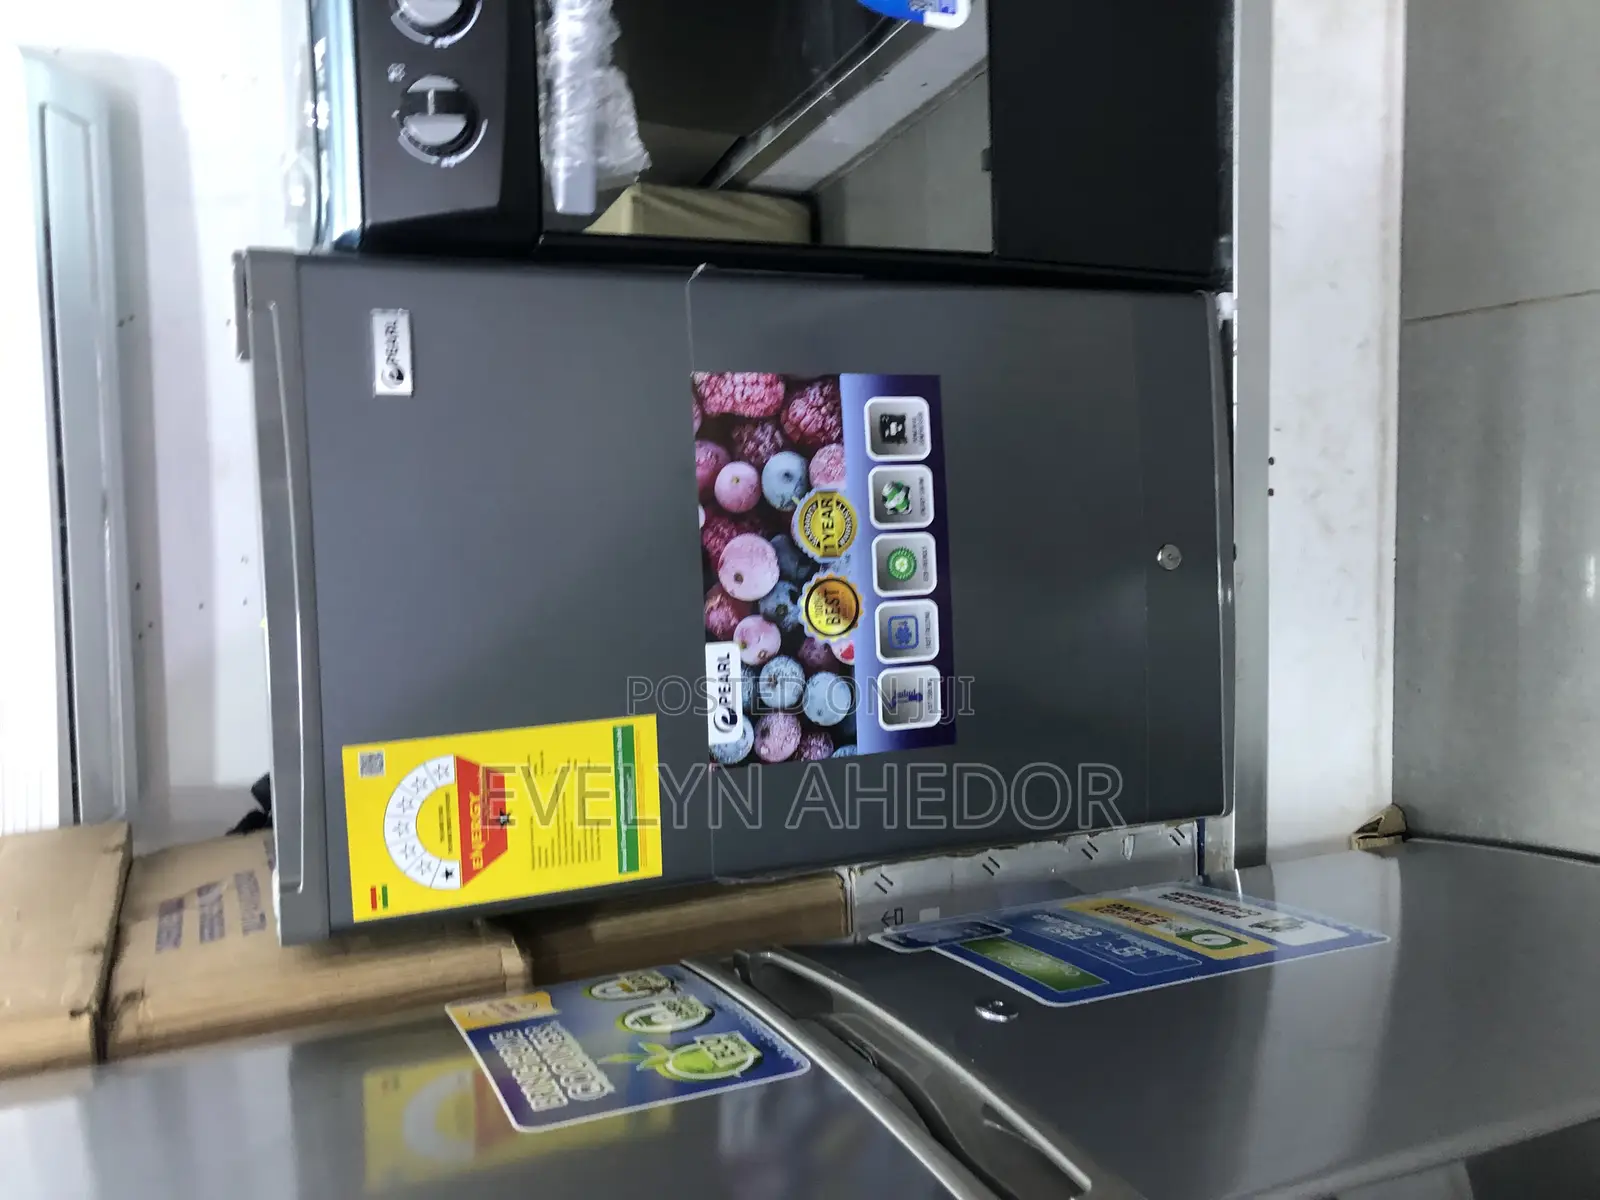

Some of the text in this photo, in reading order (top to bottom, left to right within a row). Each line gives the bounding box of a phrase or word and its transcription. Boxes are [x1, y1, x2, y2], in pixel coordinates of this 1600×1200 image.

[821, 497, 835, 541] YEAR
[824, 587, 842, 626] BEST
[715, 651, 734, 707] PEARL
[469, 791, 487, 871] ENERGY
